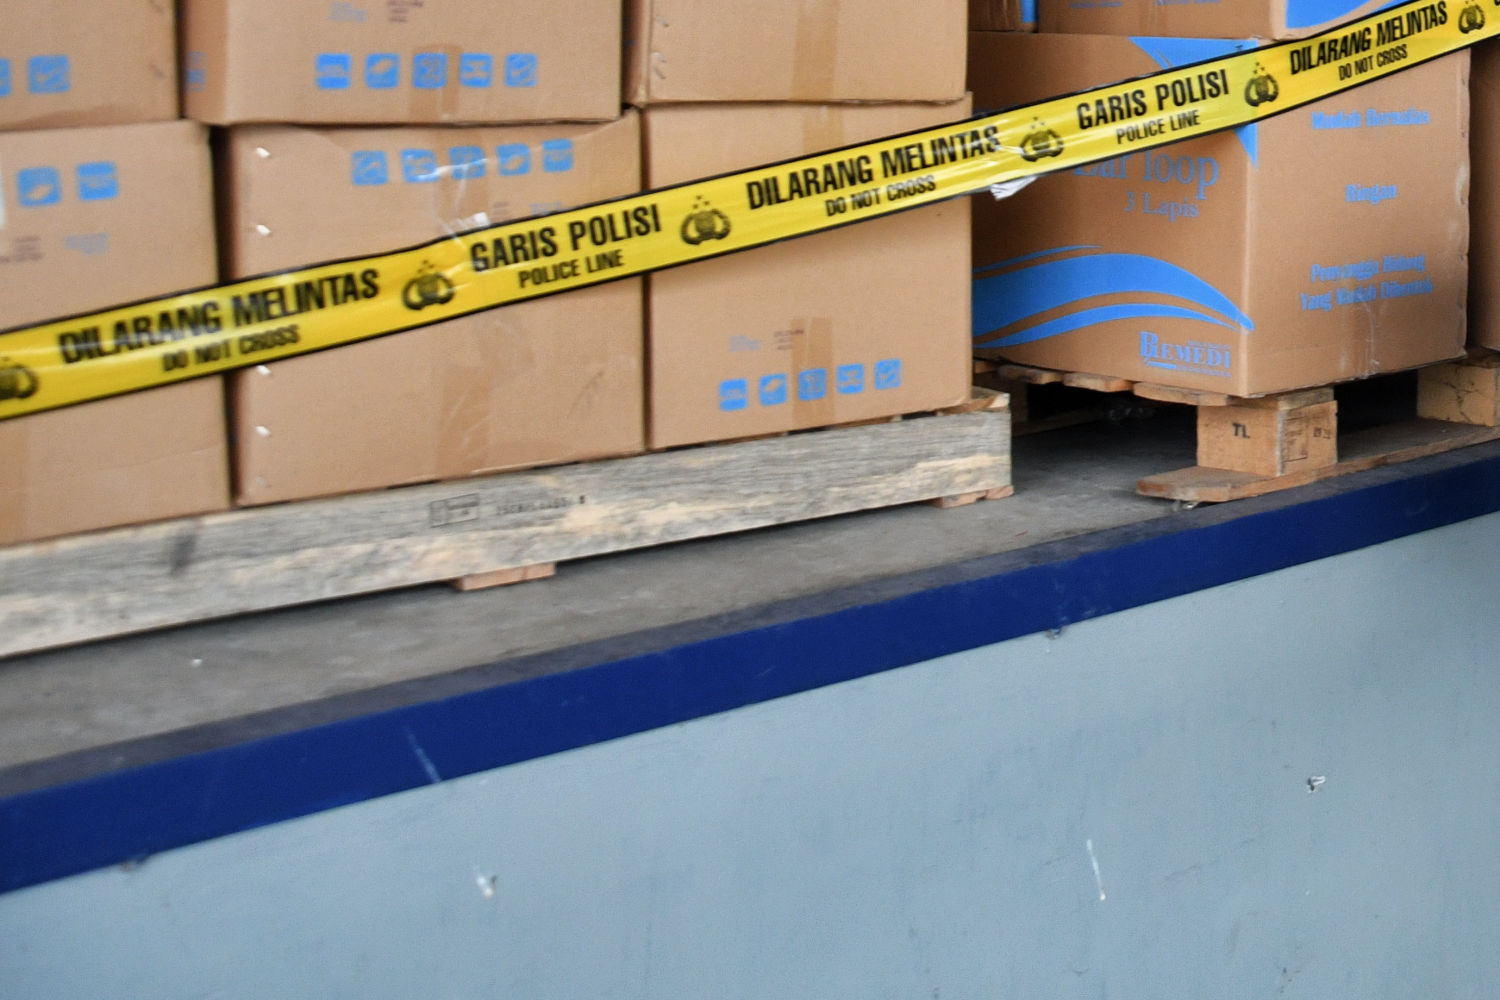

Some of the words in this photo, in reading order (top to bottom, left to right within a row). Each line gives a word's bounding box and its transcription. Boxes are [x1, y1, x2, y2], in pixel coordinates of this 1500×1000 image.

[1290, 26, 1372, 76] DILARANG
[1376, 0, 1448, 50] MELINTAS
[1338, 63, 1352, 81] DO
[1354, 54, 1375, 76] NOT
[1376, 43, 1408, 68] CROSS
[1076, 88, 1147, 130] GARIS
[1155, 68, 1230, 111] POLISI
[1115, 118, 1166, 145] POLICE
[1169, 109, 1201, 132] LINE
[746, 154, 874, 210] DILARANG
[881, 125, 1001, 179] MELINTAS
[1142, 150, 1221, 201] loop
[825, 195, 848, 218] DO
[851, 187, 882, 212] NOT
[886, 174, 937, 202] CROSS
[1124, 191, 1136, 212] 3
[1142, 191, 1200, 223] Lapis
[1345, 183, 1398, 205] Ringan
[470, 225, 559, 273] GARIS
[569, 202, 662, 252] POLISI
[518, 258, 581, 289] POLICE
[586, 248, 625, 274] LINE
[59, 300, 220, 365] DILARANG
[232, 268, 380, 327] MELINTAS
[162, 350, 190, 373] DO
[194, 339, 232, 365] NOT
[238, 324, 301, 357] CROSS
[1139, 331, 1232, 369] REMEDI
